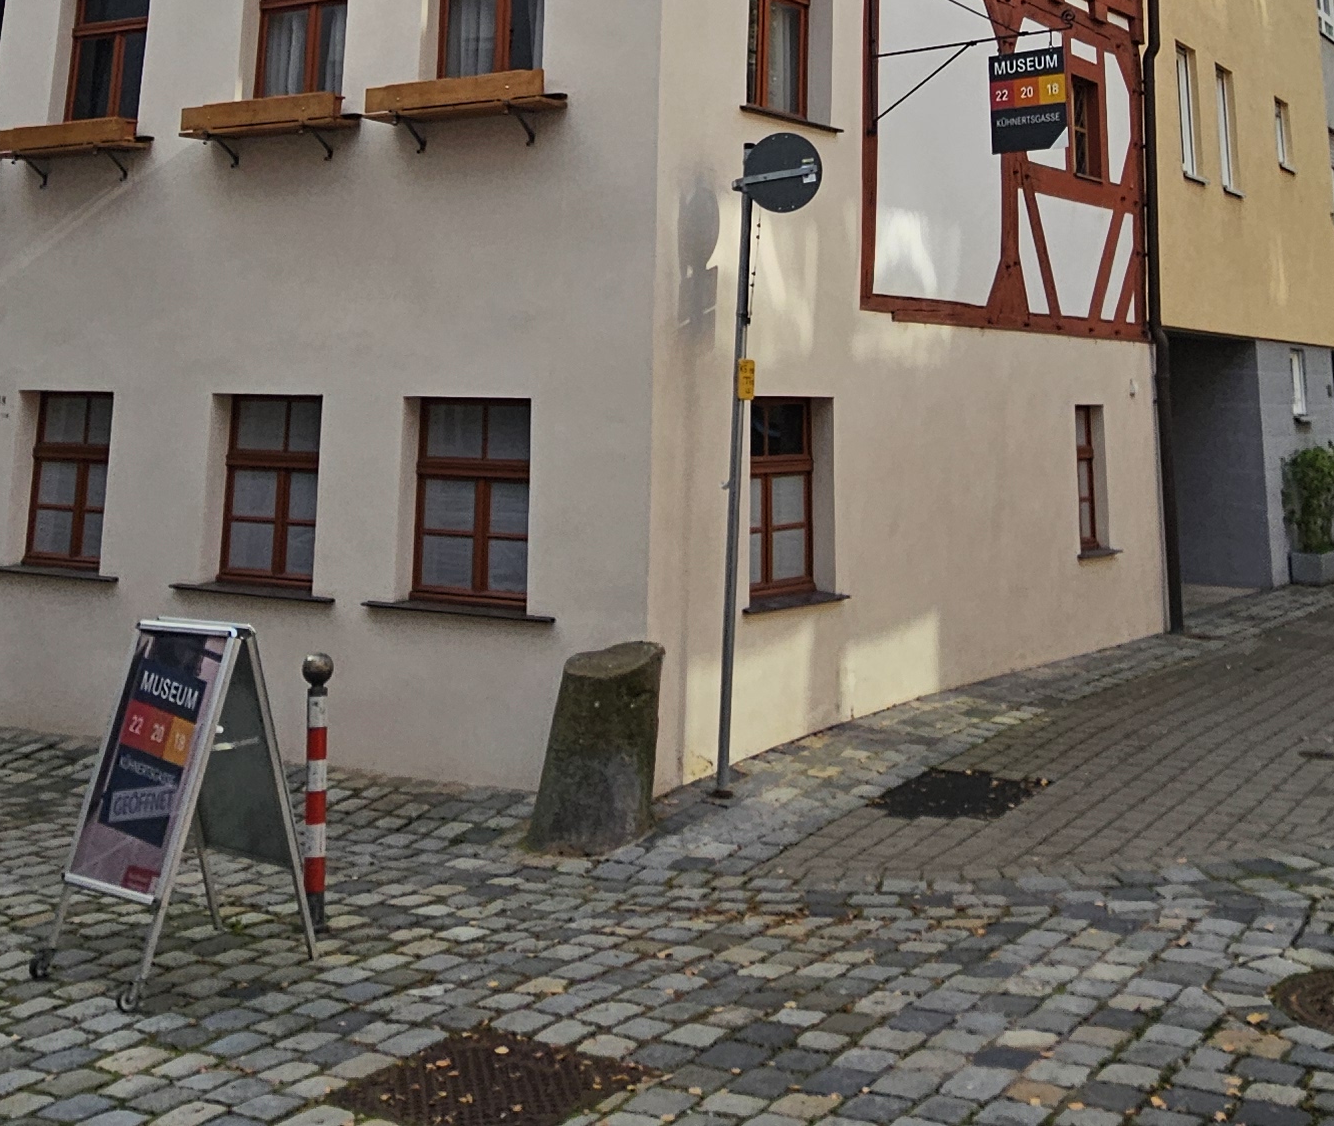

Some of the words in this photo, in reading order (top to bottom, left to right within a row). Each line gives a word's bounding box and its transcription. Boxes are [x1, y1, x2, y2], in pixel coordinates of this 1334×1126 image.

[994, 54, 1058, 75] MUSEUM
[995, 89, 1008, 102] 22
[1020, 85, 1034, 99] 20
[1046, 82, 1059, 96] 18
[996, 112, 1060, 128] KÜHNERTSGASSE
[140, 670, 199, 711] MUSEUM
[129, 714, 144, 735] 22
[150, 723, 165, 743] 20
